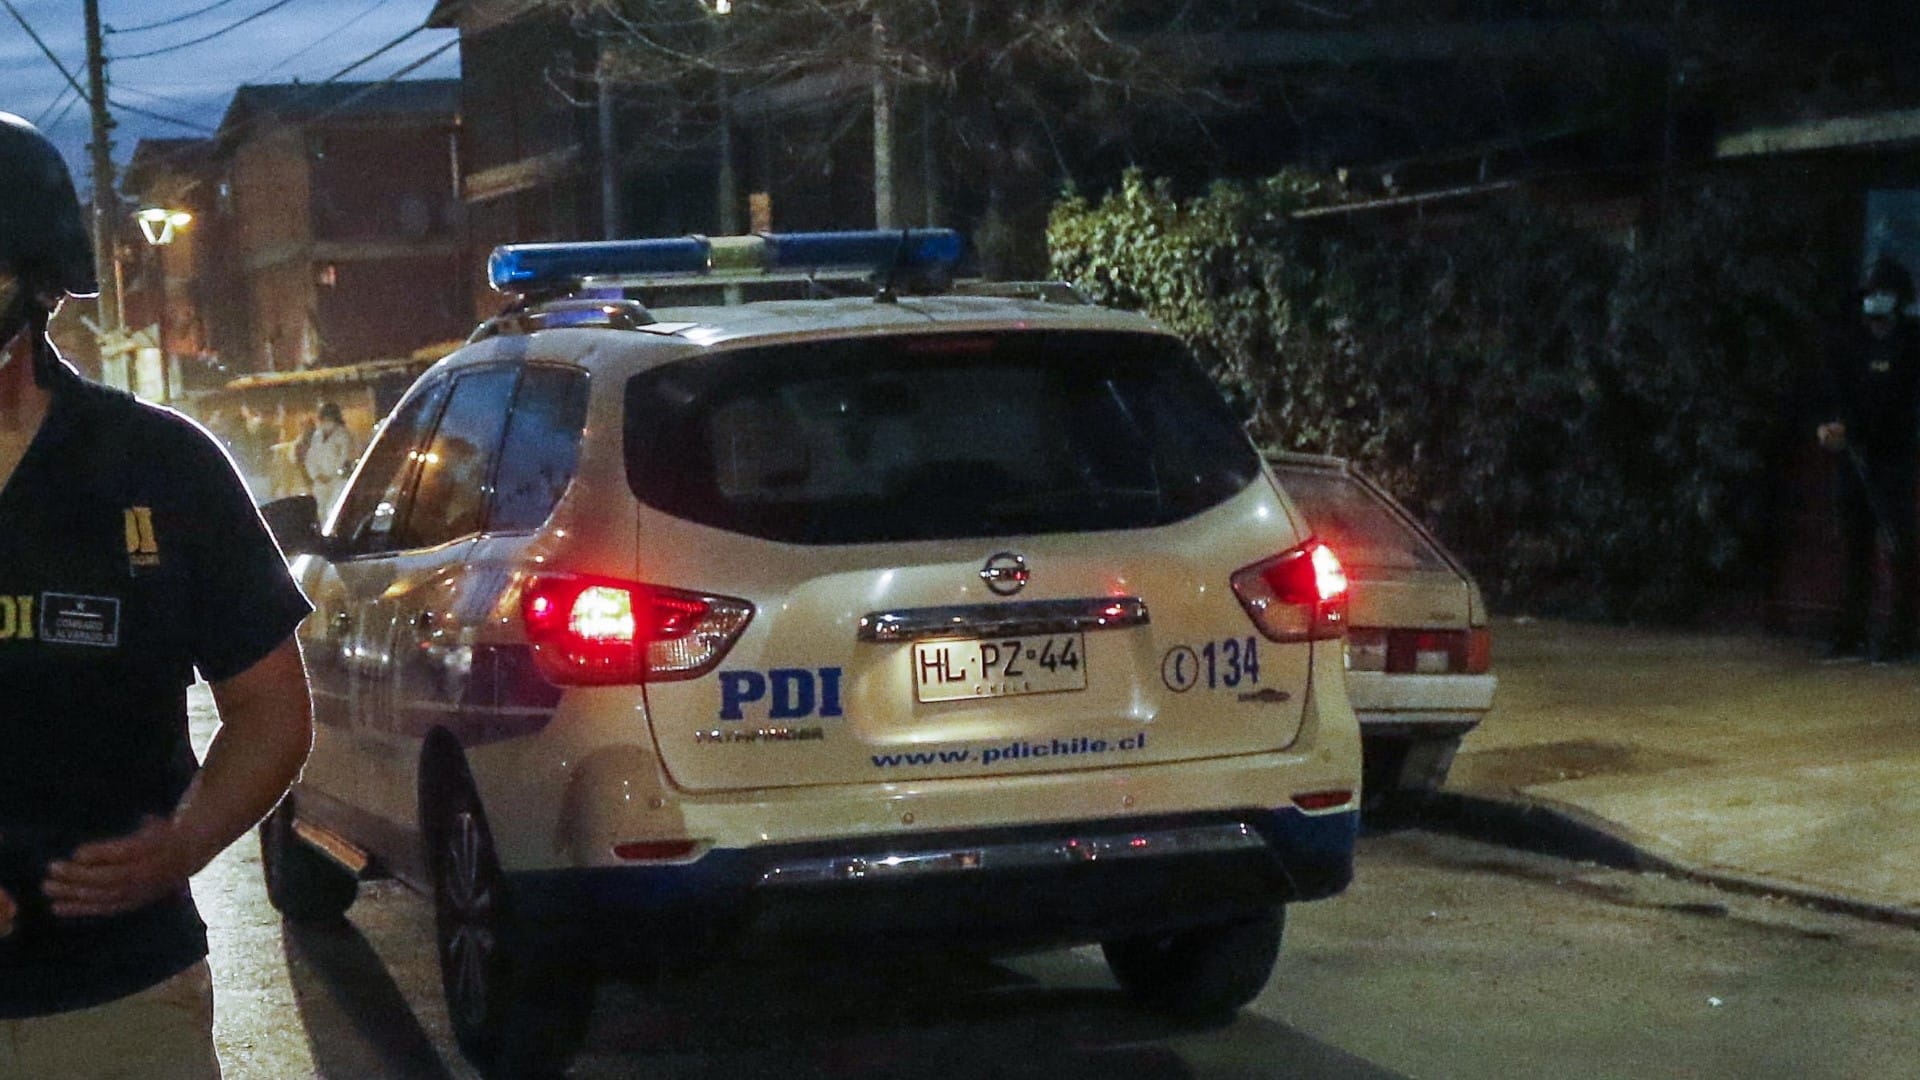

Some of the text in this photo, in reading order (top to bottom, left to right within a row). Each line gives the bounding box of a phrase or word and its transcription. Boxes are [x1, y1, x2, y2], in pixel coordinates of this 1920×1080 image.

[1203, 636, 1260, 688] 134
[719, 667, 843, 720] PDI
[872, 733, 1145, 767] www.pdichile.cl
